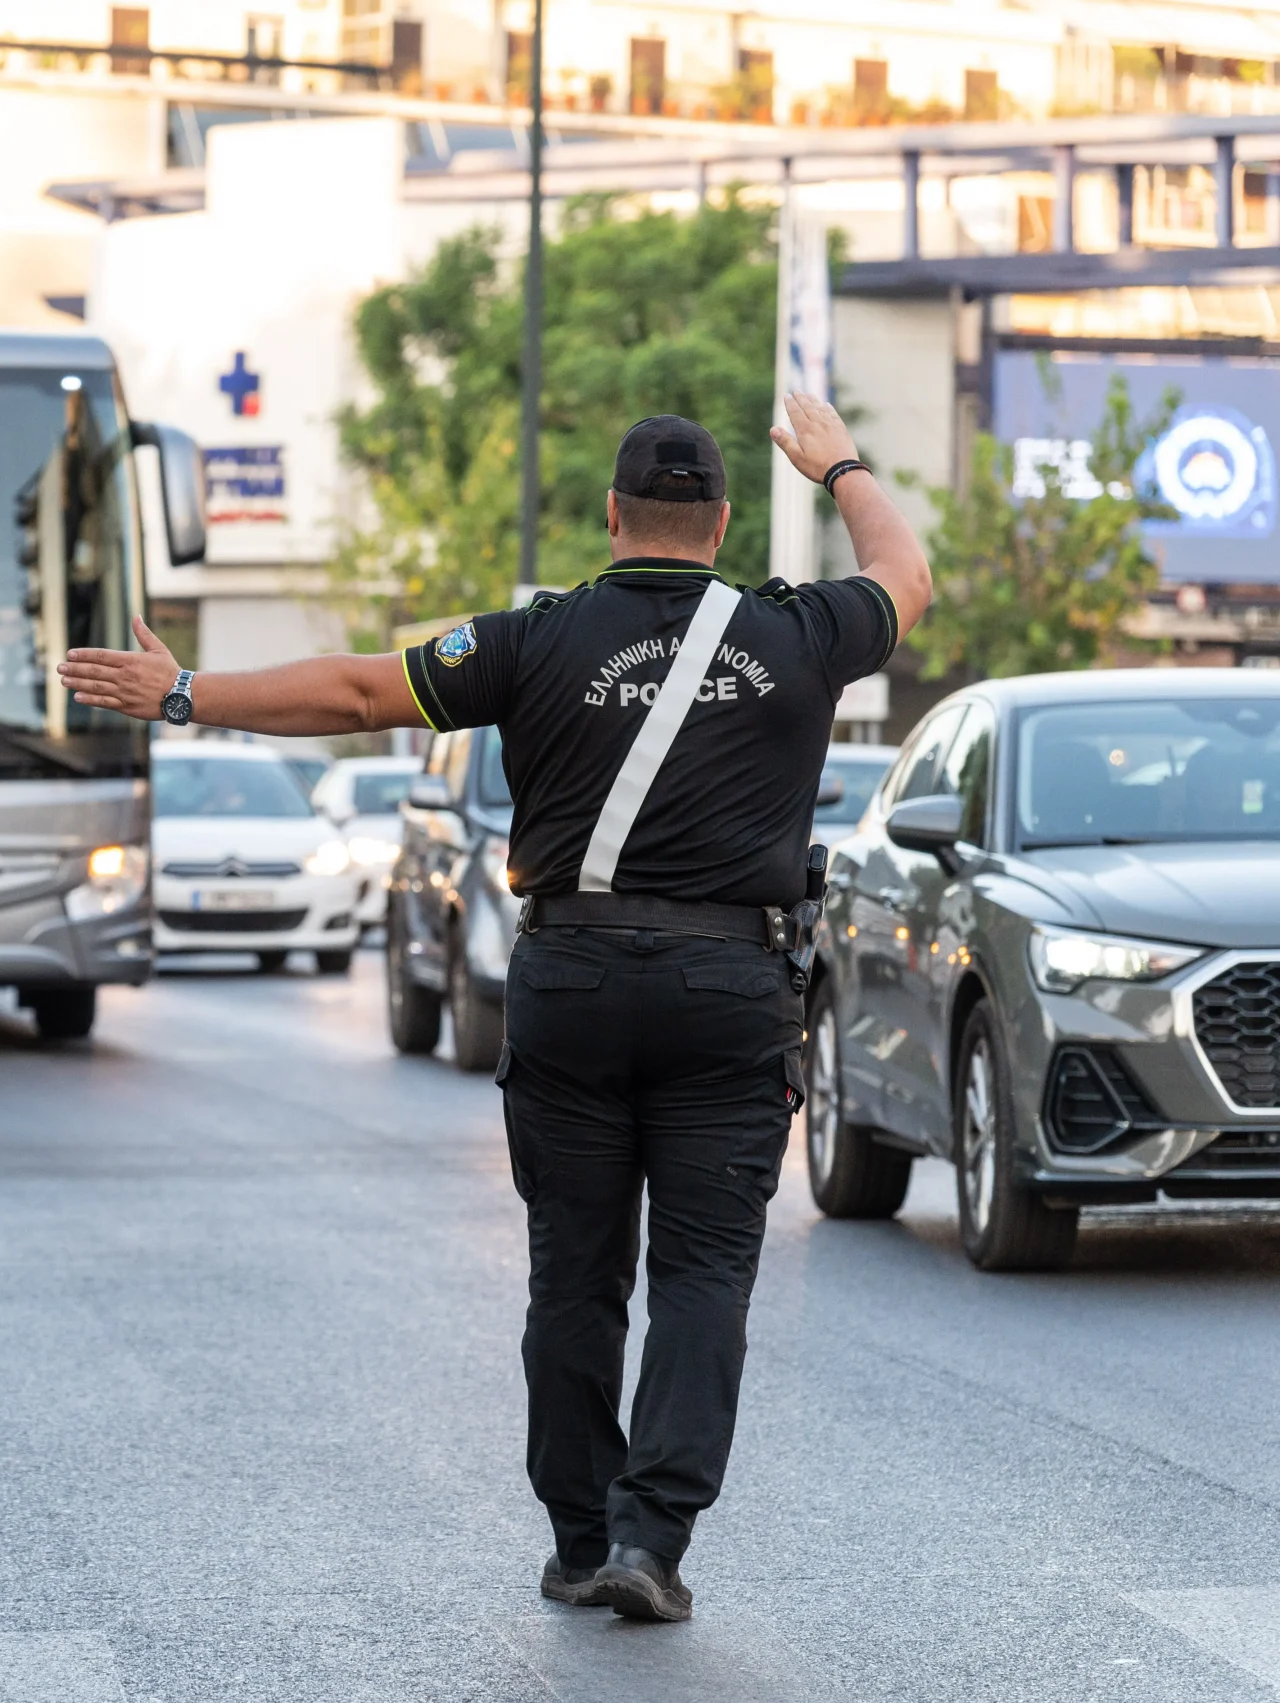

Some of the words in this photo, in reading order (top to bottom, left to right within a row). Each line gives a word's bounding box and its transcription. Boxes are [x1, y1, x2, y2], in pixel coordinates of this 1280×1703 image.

[584, 638, 665, 706] ΕΛΛΗΝΙΚΗ
[669, 636, 776, 698] ΑΝΟΜΙΑ
[619, 676, 738, 707] POCE
